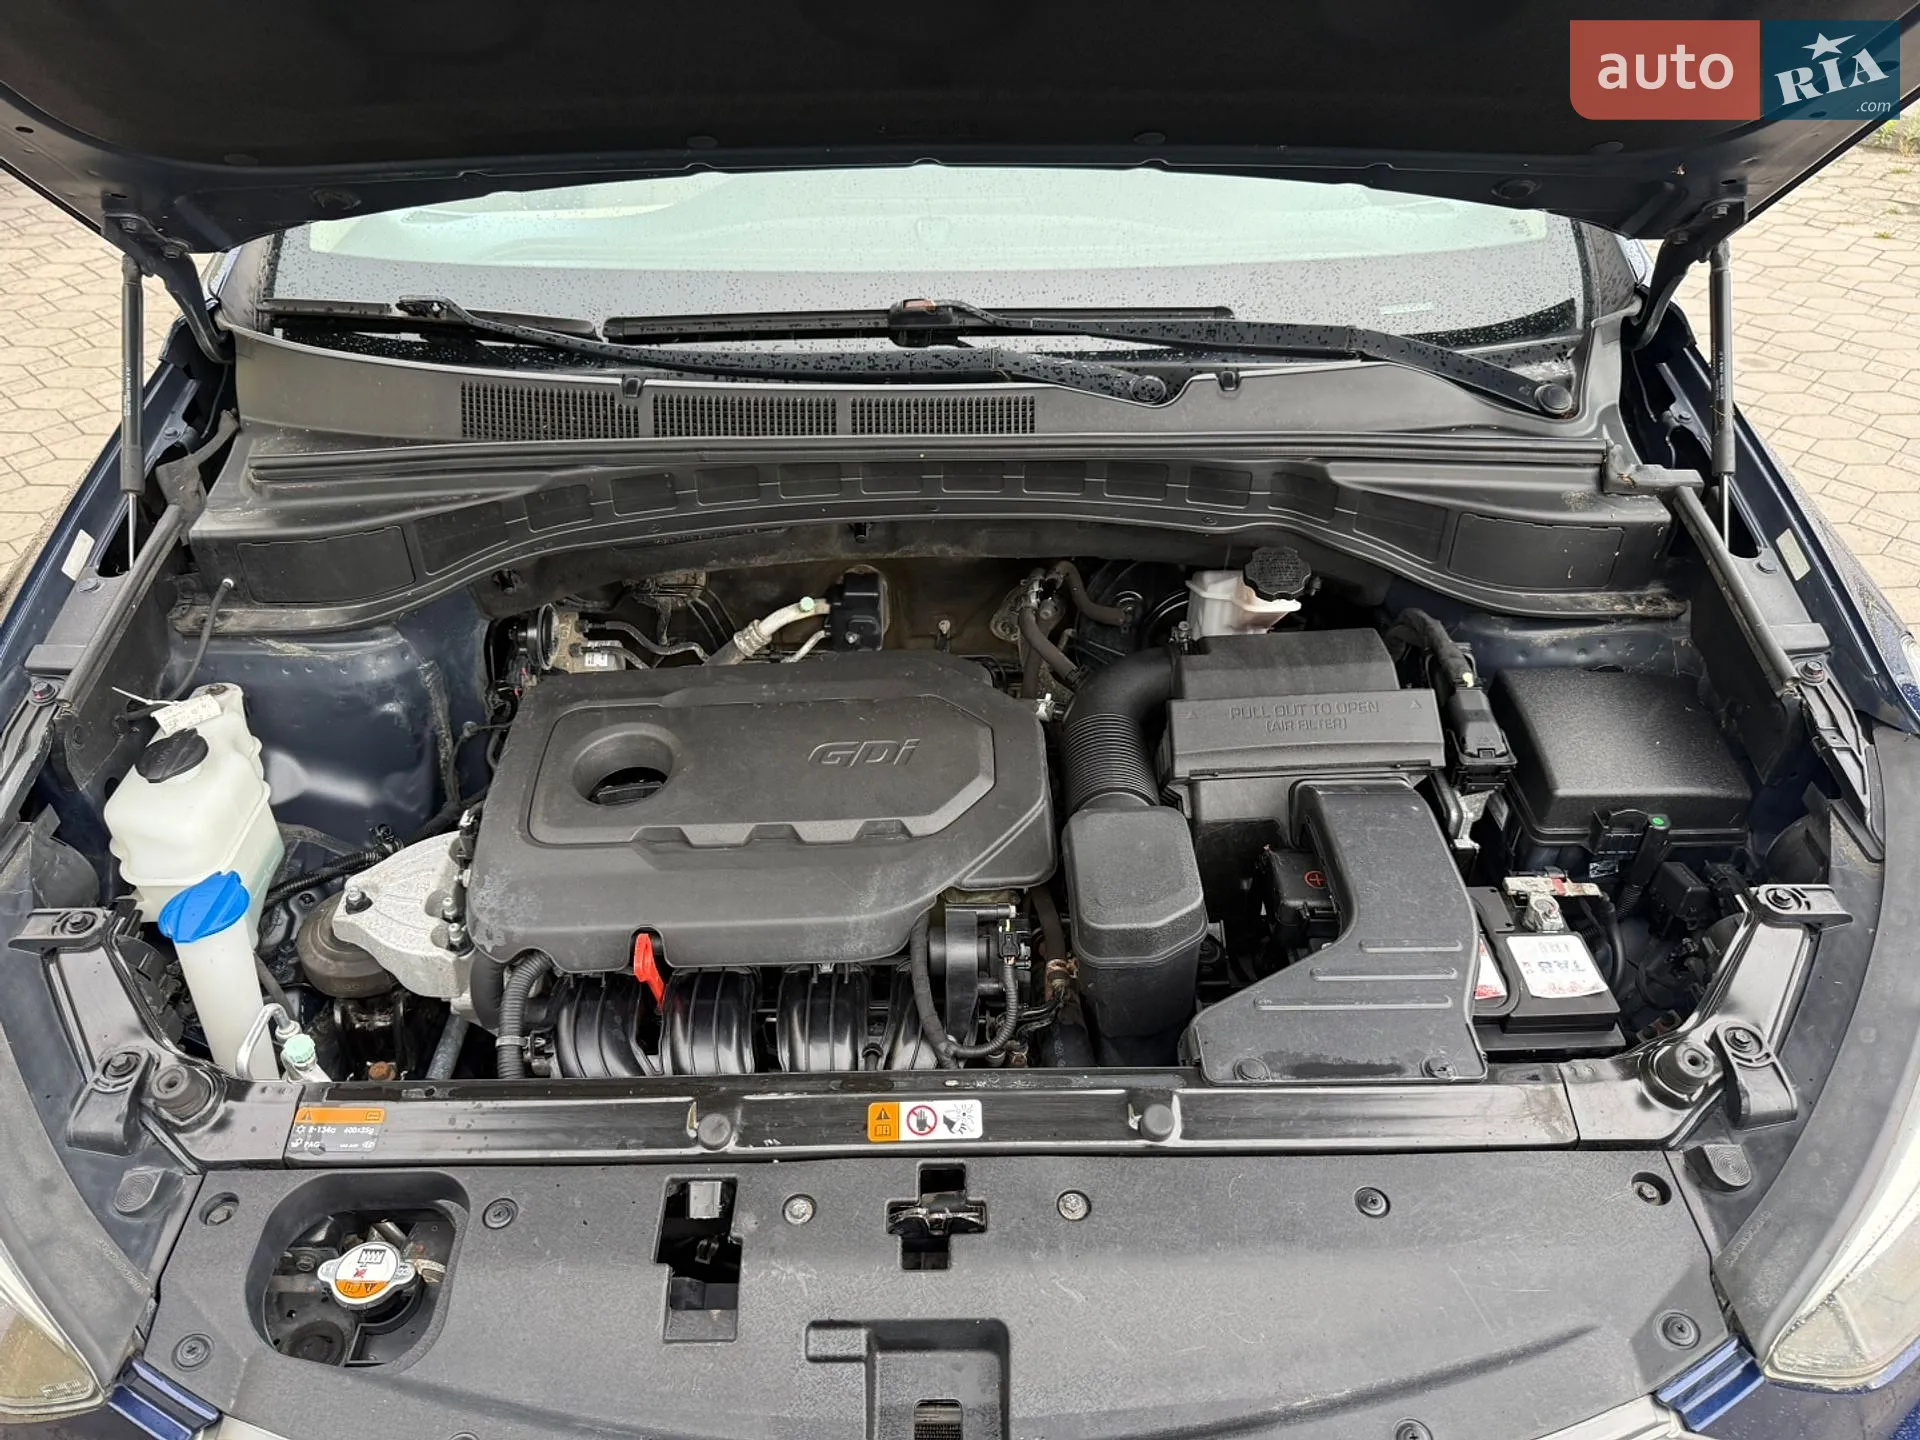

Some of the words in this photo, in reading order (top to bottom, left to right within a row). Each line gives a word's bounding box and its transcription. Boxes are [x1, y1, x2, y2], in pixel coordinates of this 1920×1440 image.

[1229, 704, 1271, 720] PULL
[1273, 703, 1306, 718] OUT
[1311, 702, 1332, 716] TO
[1335, 701, 1380, 715] OPEN
[1265, 718, 1294, 733] (AIR
[1296, 717, 1349, 732] FILTER)
